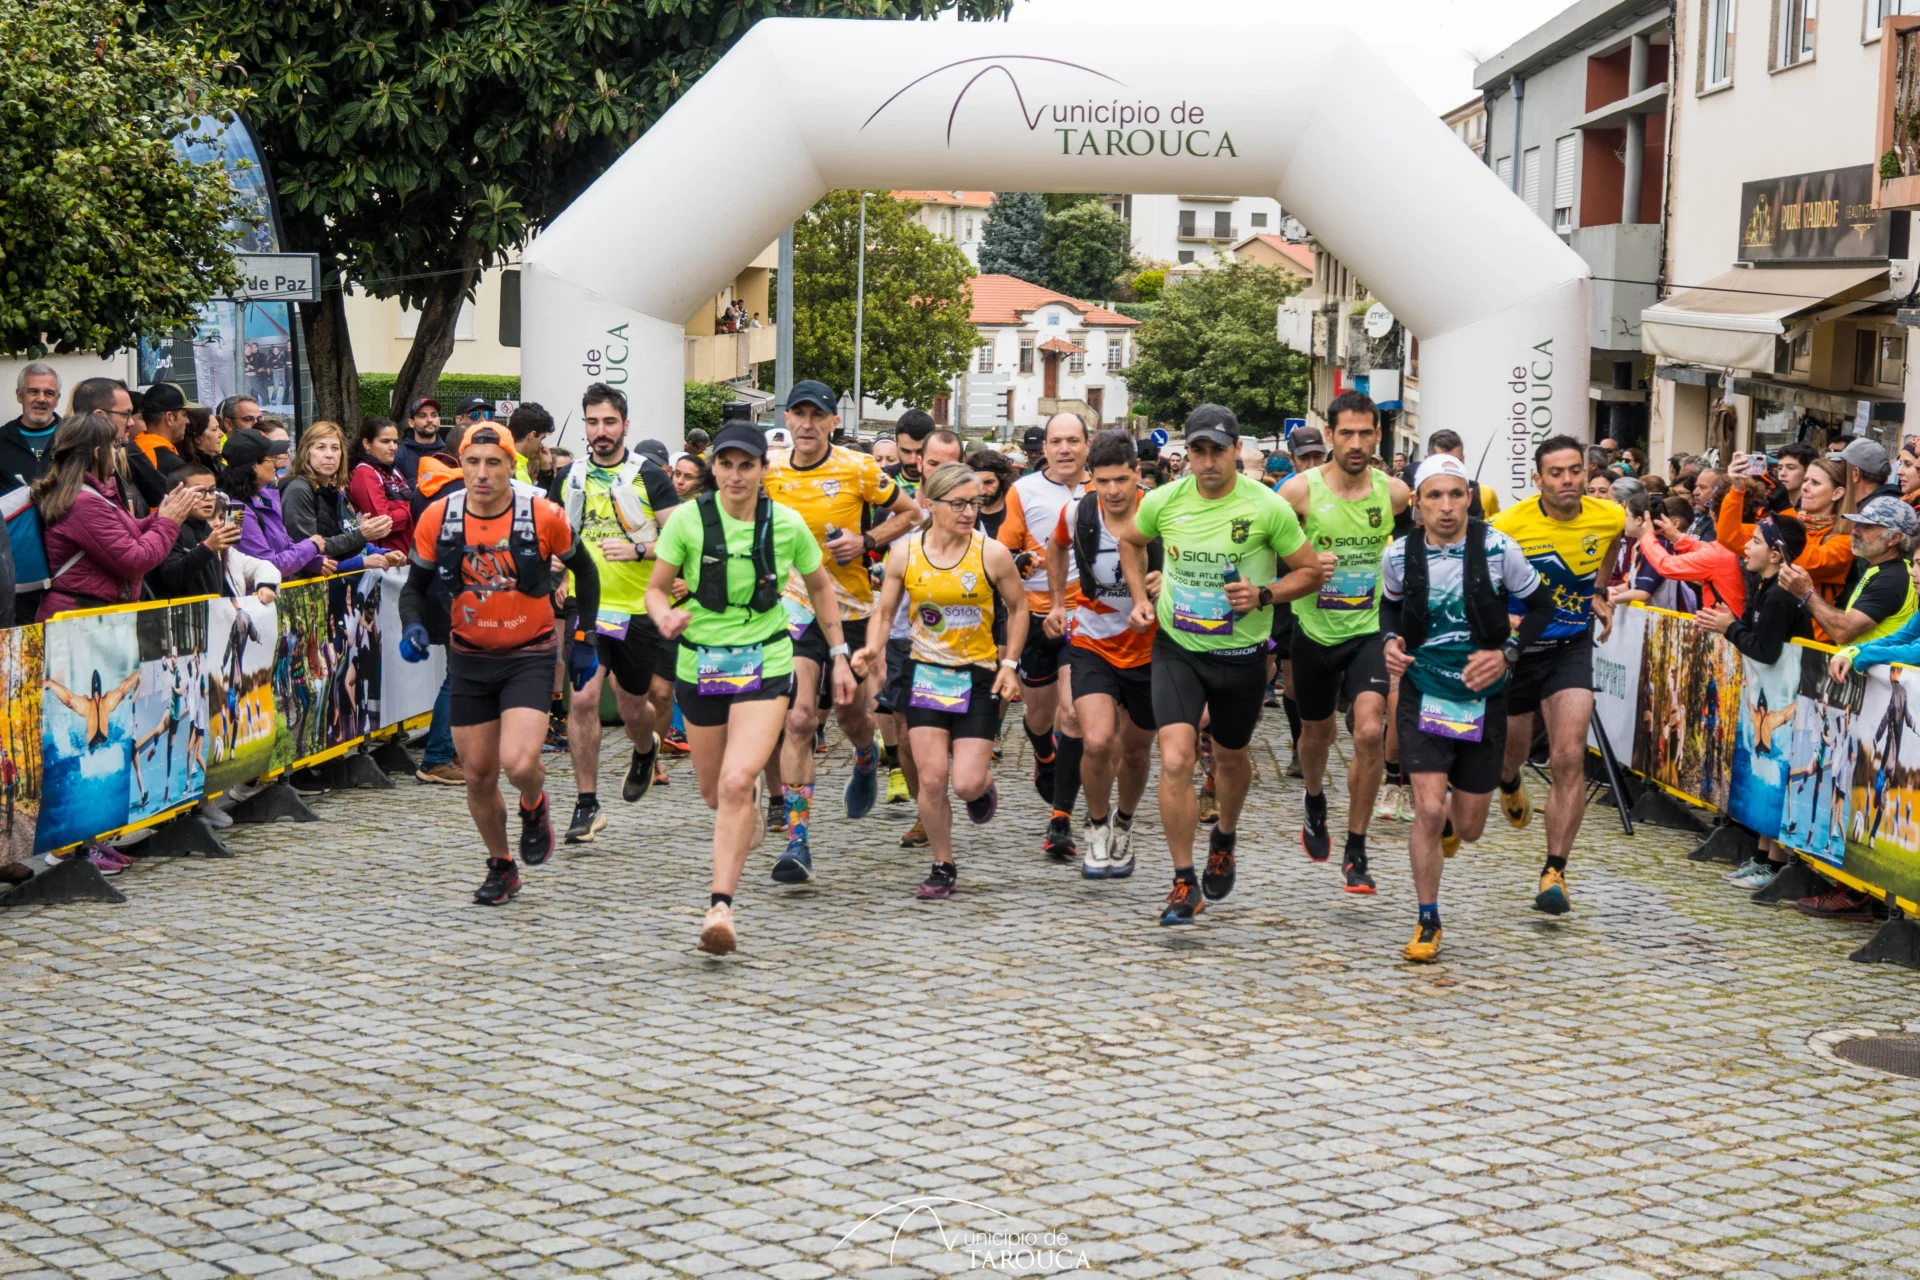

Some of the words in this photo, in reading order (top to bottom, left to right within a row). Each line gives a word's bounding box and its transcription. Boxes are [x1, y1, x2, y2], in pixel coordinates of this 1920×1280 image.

[1171, 100, 1204, 124] de
[1055, 128, 1240, 157] TAROUCA
[1781, 203, 1801, 230] PURA
[1803, 200, 1840, 229] VAIDADE
[1845, 204, 1865, 219] BEAUTY
[249, 276, 269, 290] de
[275, 276, 307, 291] Paz
[1370, 312, 1390, 320] meo
[583, 349, 602, 376] de
[1508, 366, 1527, 394] de
[1199, 572, 1224, 580] ATLÉT
[1321, 585, 1338, 593] 20K
[1356, 586, 1368, 596] 33
[1175, 601, 1191, 612] 20K
[1211, 607, 1224, 619] 32
[611, 613, 622, 625] 24
[700, 664, 719, 674] 20K
[741, 662, 754, 675] 60
[915, 680, 932, 689] 20K
[952, 685, 962, 697] 31
[1424, 703, 1442, 715] 20K
[1461, 710, 1474, 723] 34
